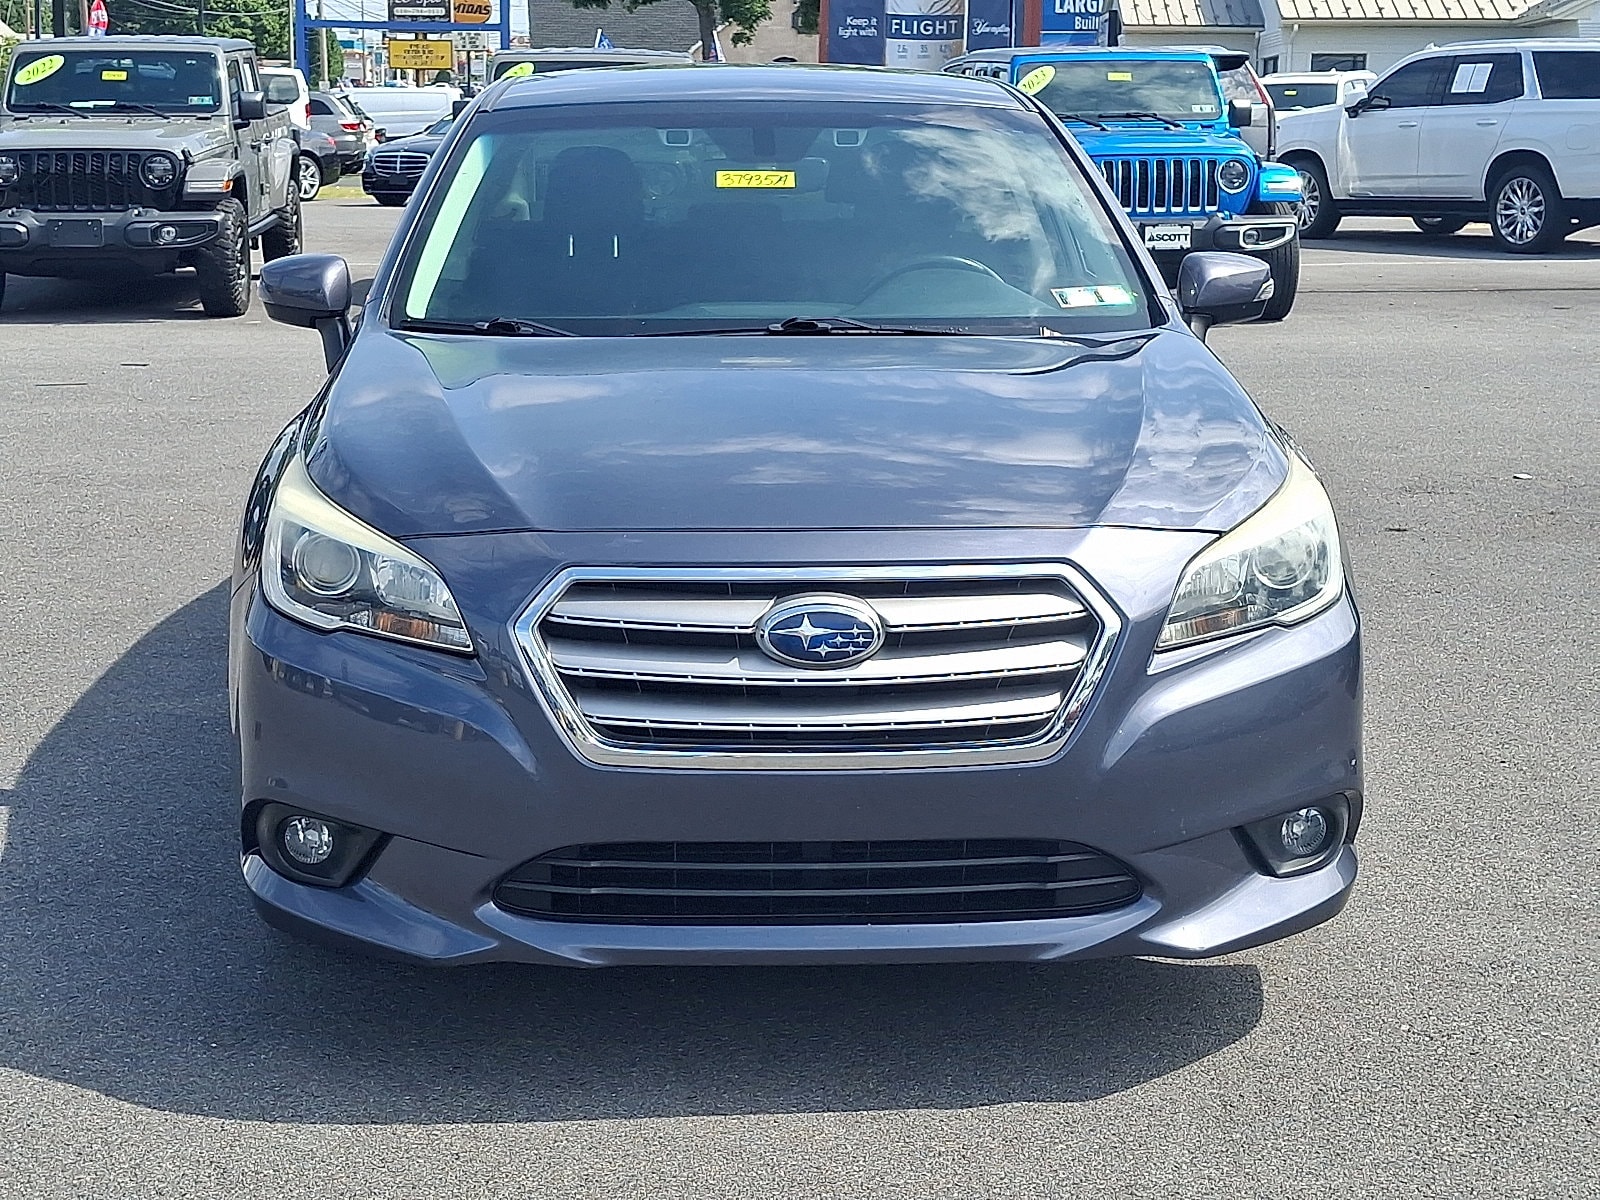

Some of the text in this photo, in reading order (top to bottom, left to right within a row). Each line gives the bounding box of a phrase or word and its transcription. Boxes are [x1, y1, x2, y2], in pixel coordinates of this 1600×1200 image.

[454, 3, 492, 15] MIDAS
[846, 16, 878, 27] Keep it
[891, 20, 958, 35] FLIGHT
[838, 27, 878, 38] light with
[25, 59, 54, 81] 2022
